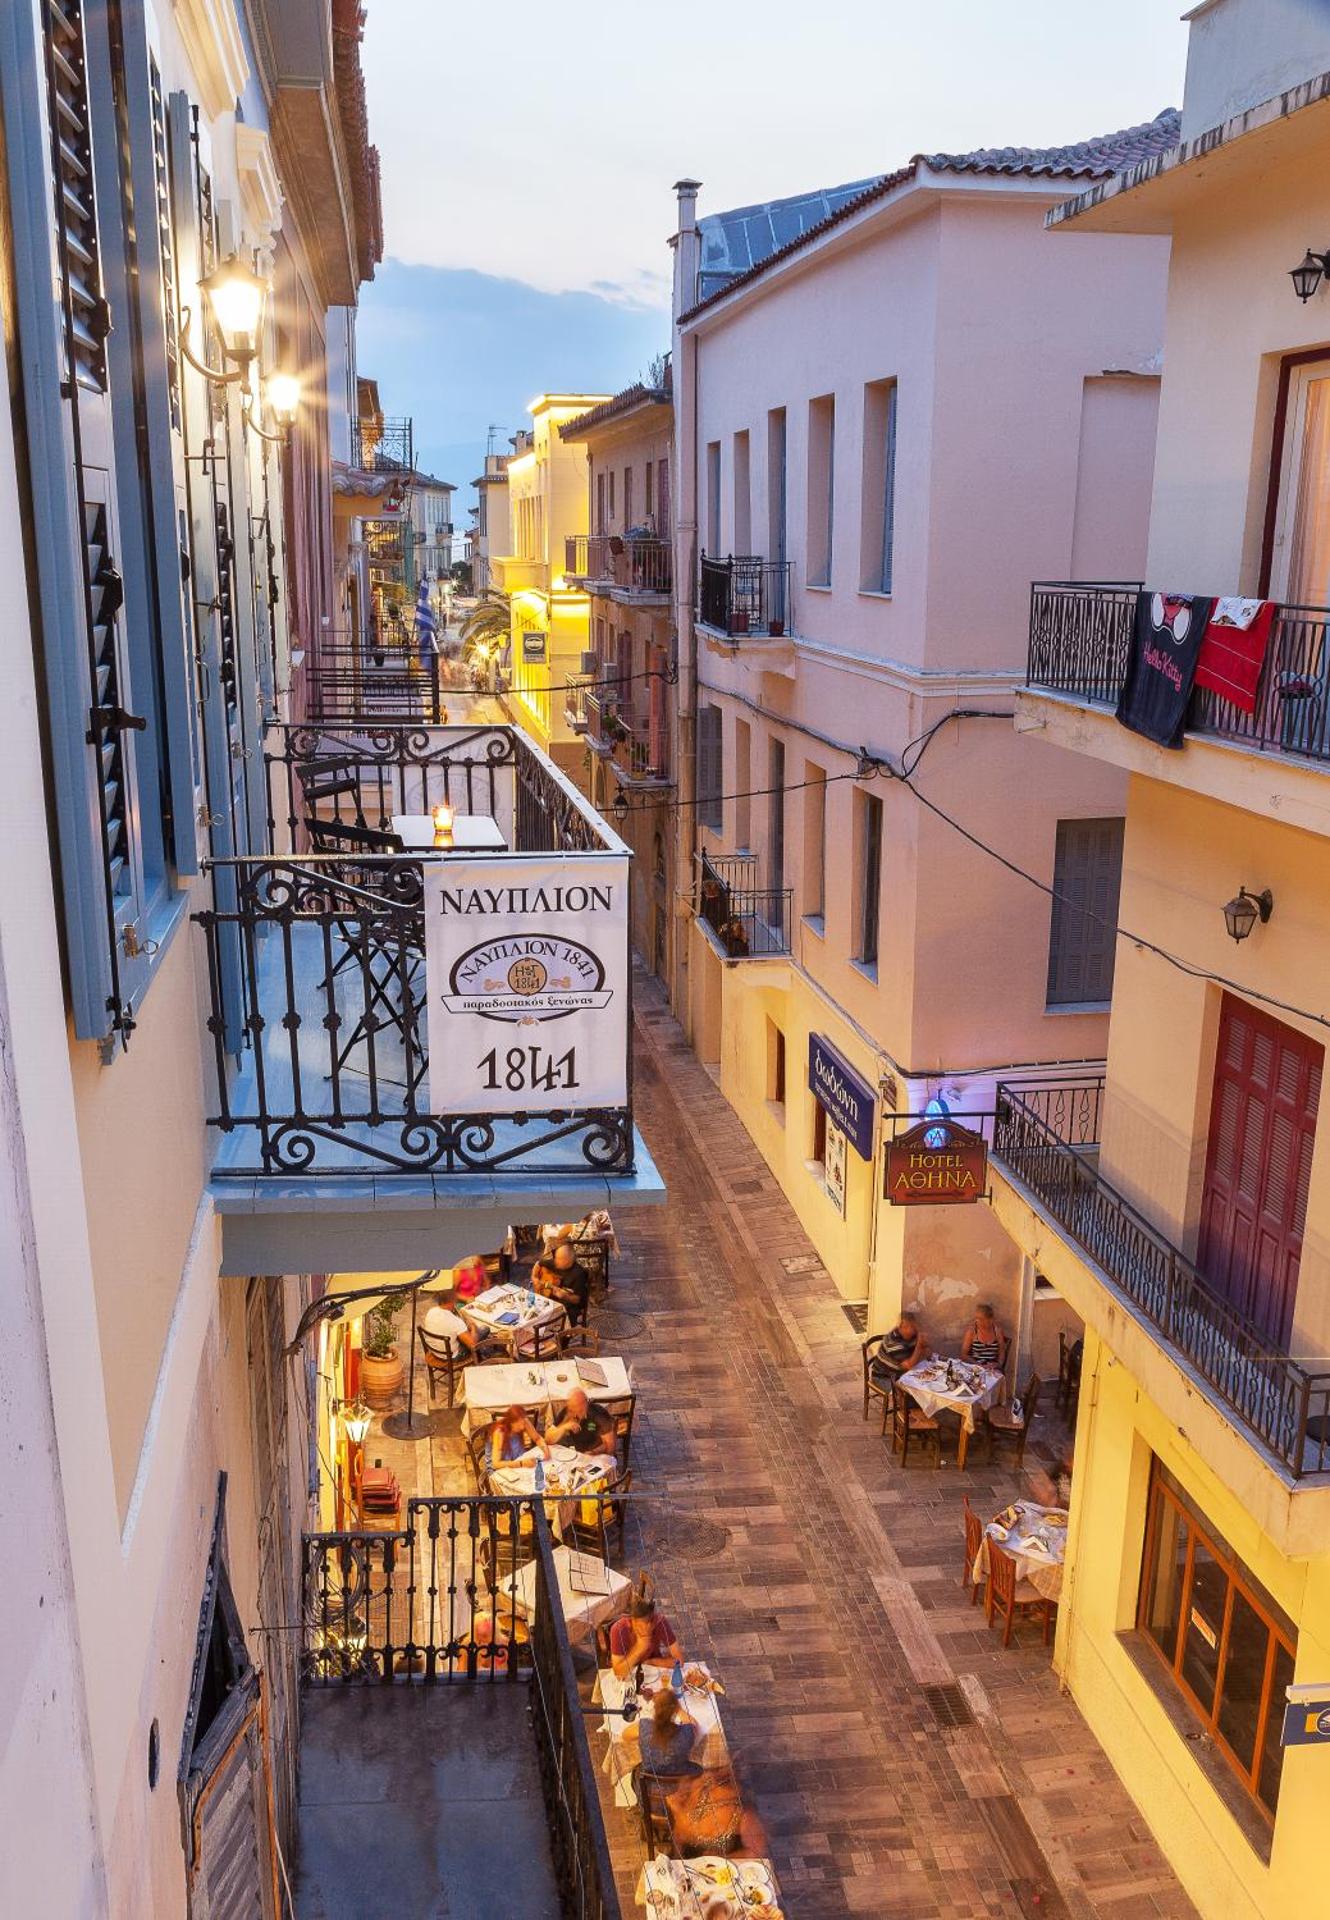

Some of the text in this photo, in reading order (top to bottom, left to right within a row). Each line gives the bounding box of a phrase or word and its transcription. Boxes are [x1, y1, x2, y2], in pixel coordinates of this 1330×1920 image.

[1144, 641, 1183, 692] Hello Kitty
[440, 886, 613, 915] ΝΑΥΠΛΙΟΝ
[459, 940, 595, 984] ΝΑΥΠΛΙΟΝ 1841
[477, 1046, 580, 1092] 1841
[909, 1153, 964, 1169] HOTEL
[895, 1170, 977, 1190] ΑΘΗΝΑ
